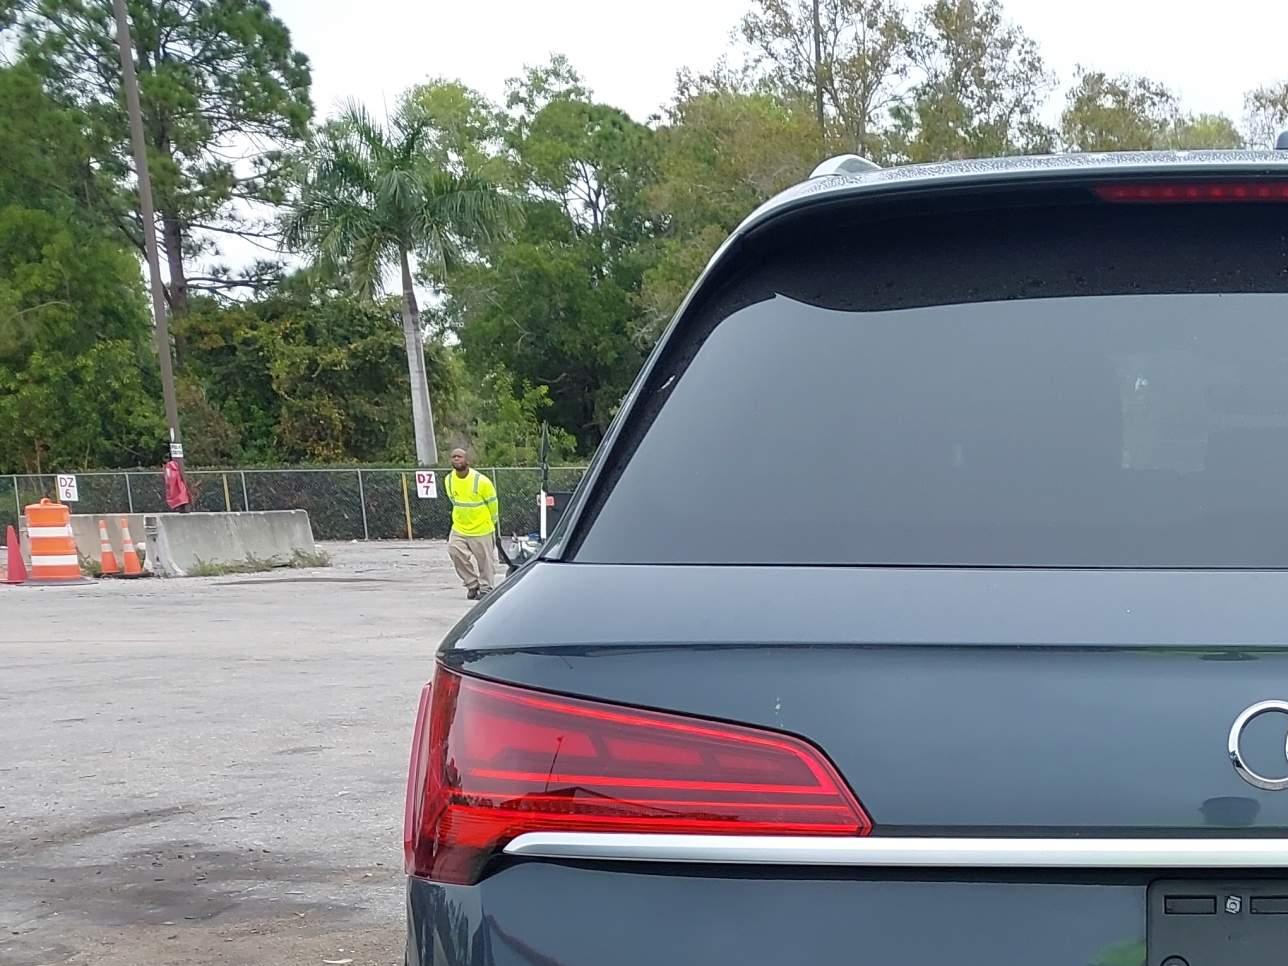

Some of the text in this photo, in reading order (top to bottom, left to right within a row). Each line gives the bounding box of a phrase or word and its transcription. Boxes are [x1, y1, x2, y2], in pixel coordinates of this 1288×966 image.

[59, 477, 75, 488] DZ
[417, 473, 434, 484] DZ
[65, 489, 72, 499] 6
[423, 485, 430, 496] 7
